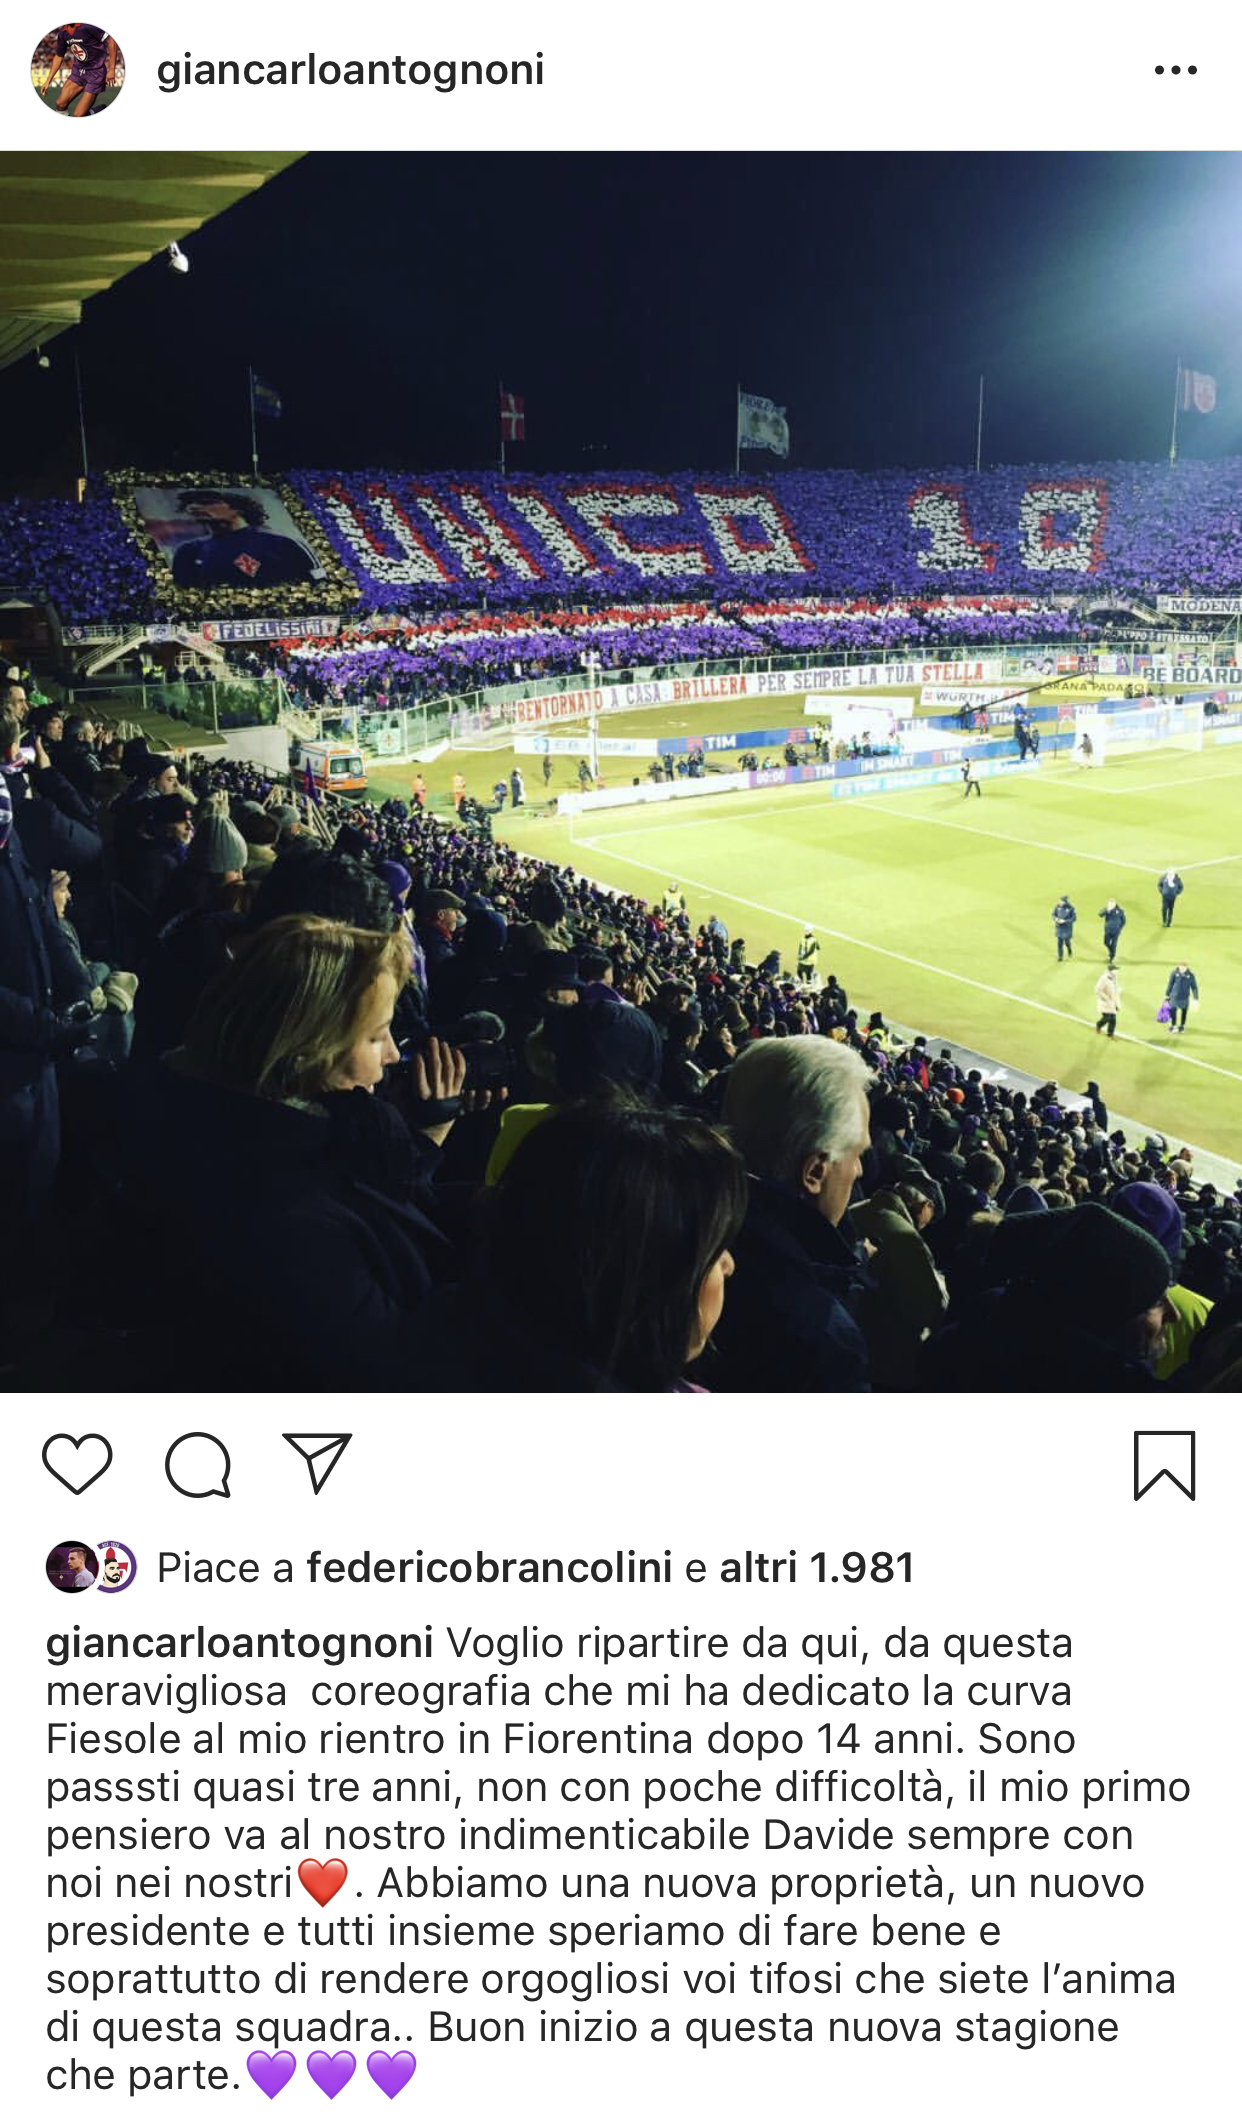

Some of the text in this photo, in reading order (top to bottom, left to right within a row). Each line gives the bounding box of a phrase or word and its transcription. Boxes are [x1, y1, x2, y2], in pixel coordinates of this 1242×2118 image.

[310, 478, 1107, 584] UNICO 10
[626, 682, 661, 705] CASA
[757, 673, 786, 693] PER
[793, 668, 852, 690] SEMPRE
[858, 667, 878, 686] LA
[885, 664, 914, 683] TUA
[921, 662, 983, 682] STELLA
[705, 734, 736, 749] TIM
